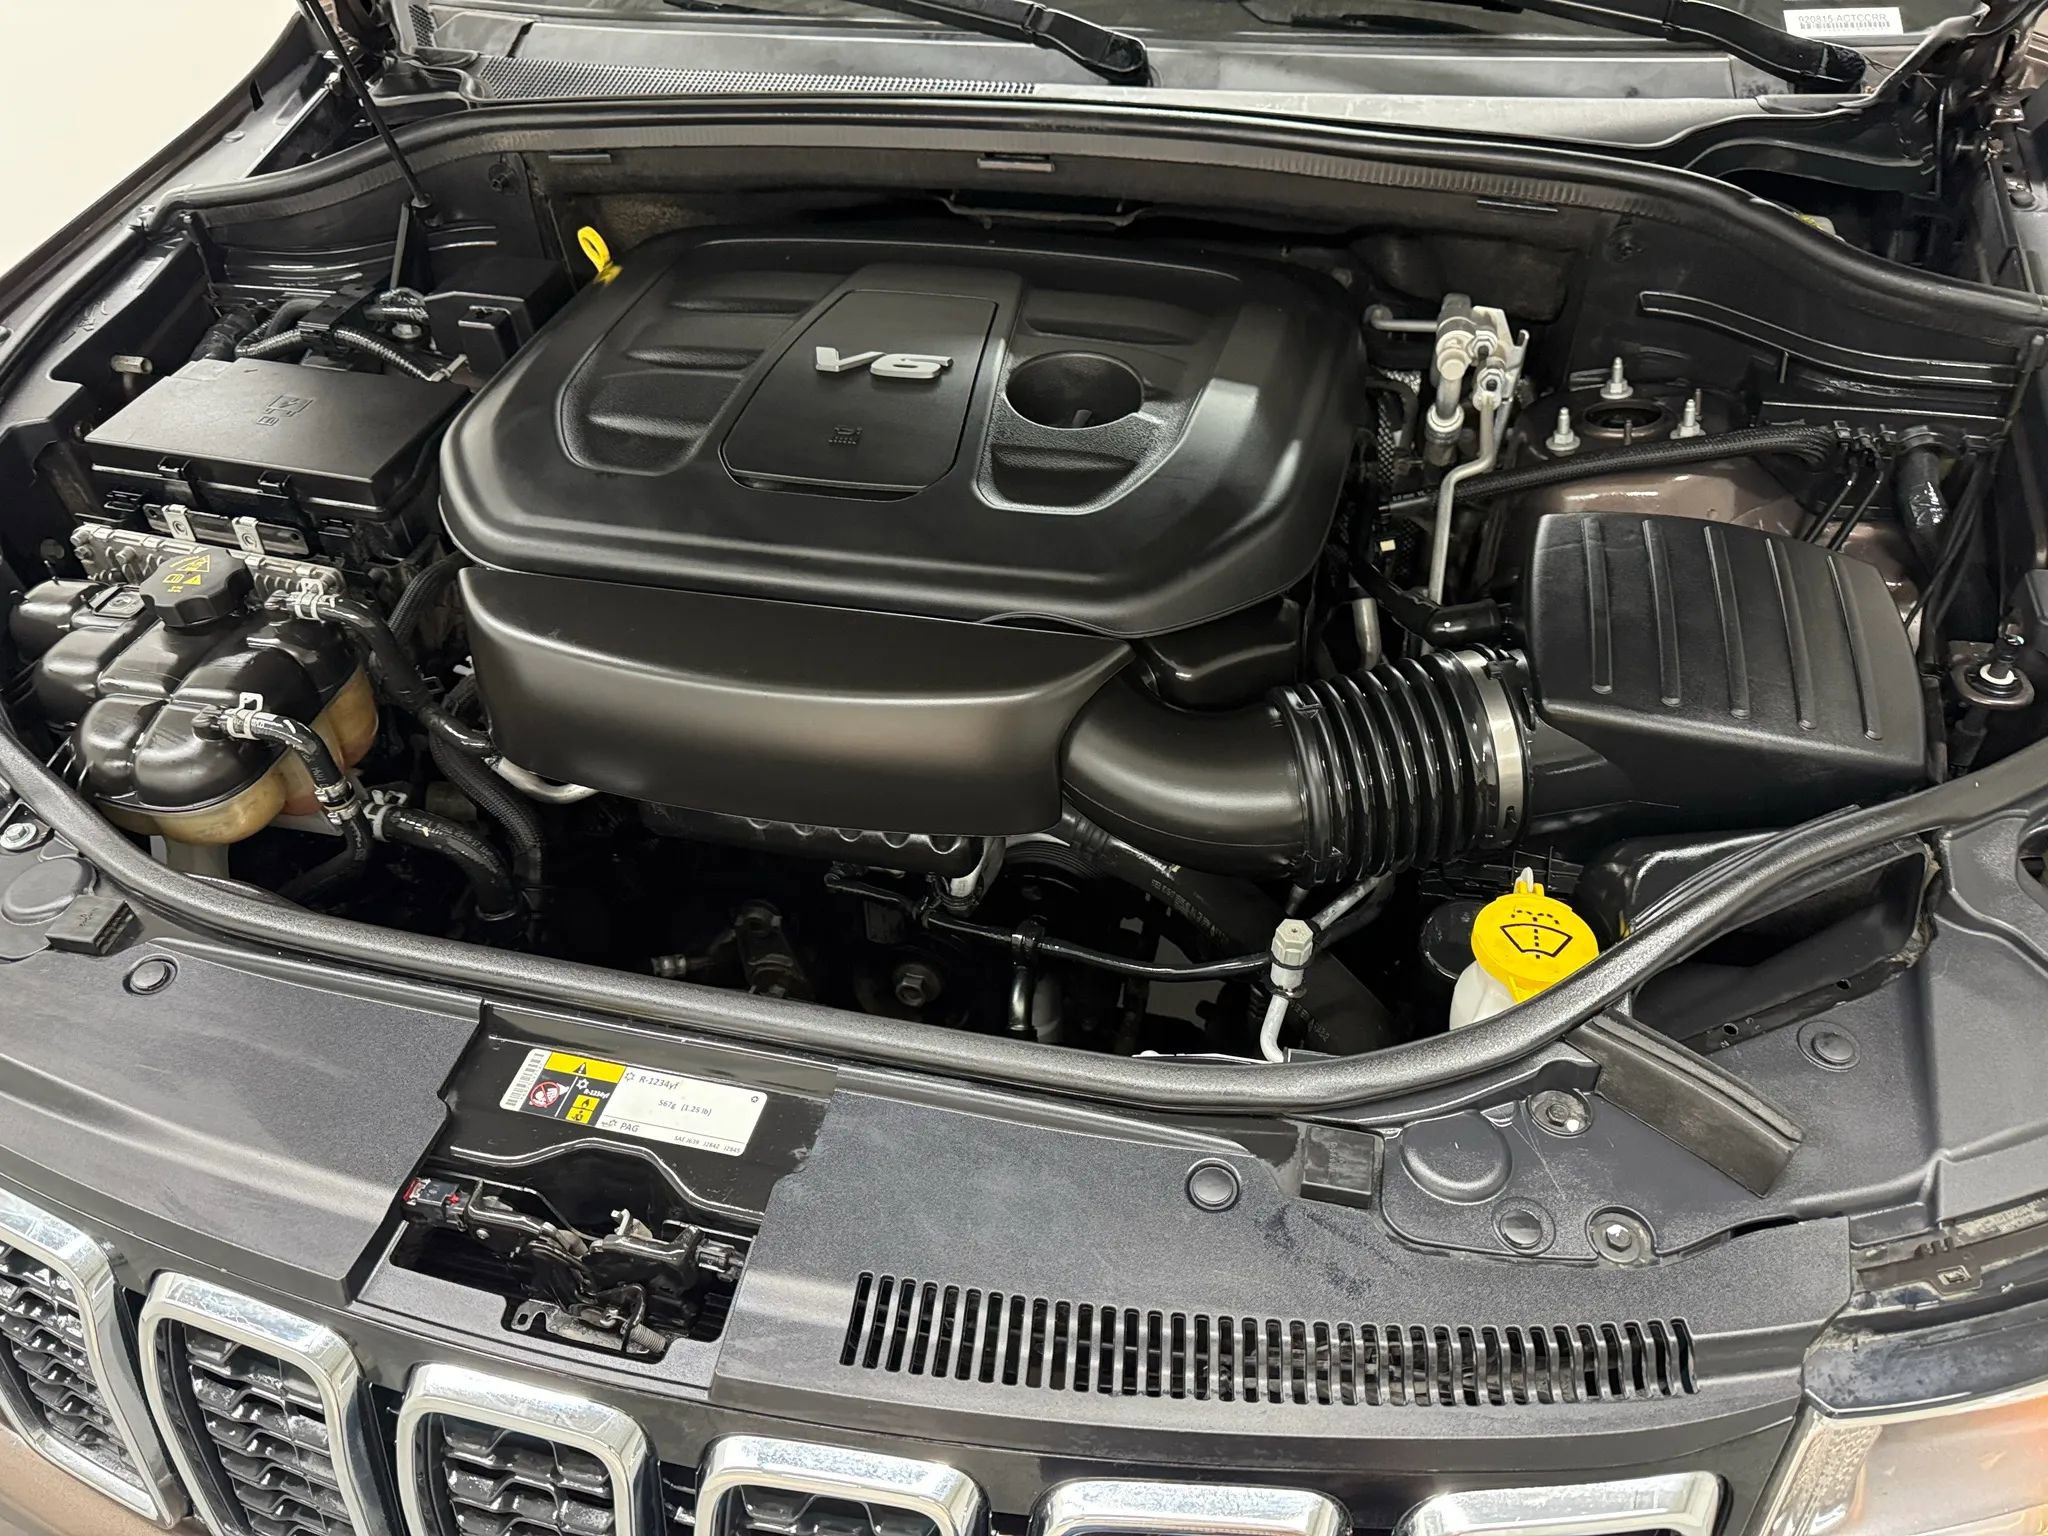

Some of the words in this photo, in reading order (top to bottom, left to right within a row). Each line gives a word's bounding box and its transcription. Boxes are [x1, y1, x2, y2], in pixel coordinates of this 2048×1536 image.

[815, 345, 954, 379] V6
[638, 1075, 680, 1090] R-1234yf
[658, 1099, 678, 1111] 567g
[619, 1122, 641, 1134] PAG
